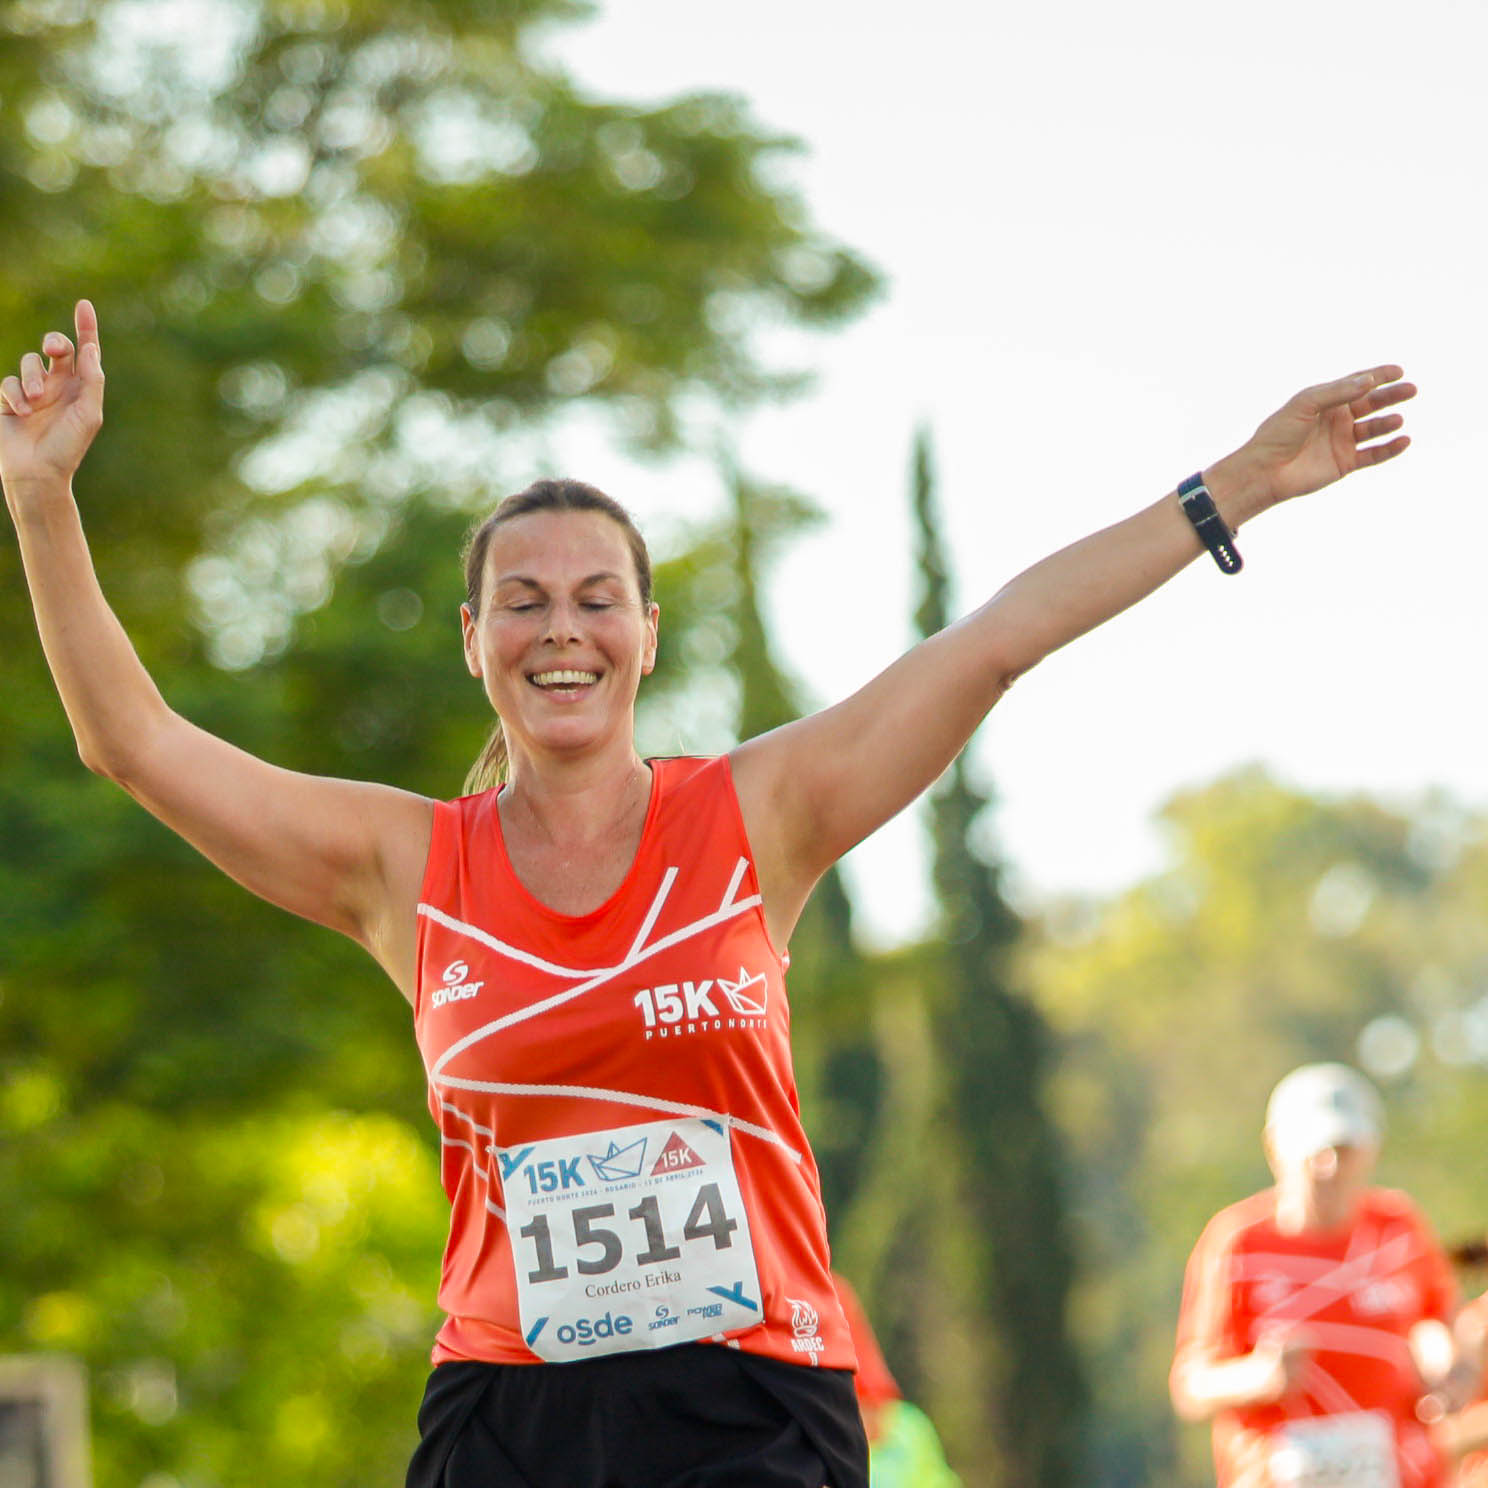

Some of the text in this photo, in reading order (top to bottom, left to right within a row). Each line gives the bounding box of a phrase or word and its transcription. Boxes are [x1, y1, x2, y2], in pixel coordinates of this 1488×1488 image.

[634, 979, 720, 1028] 15K
[523, 1156, 585, 1195] 15K
[663, 1147, 693, 1169] 15K
[520, 1183, 738, 1284] 1514
[585, 1270, 682, 1298] Cordero Erika
[557, 1312, 633, 1345] osde
